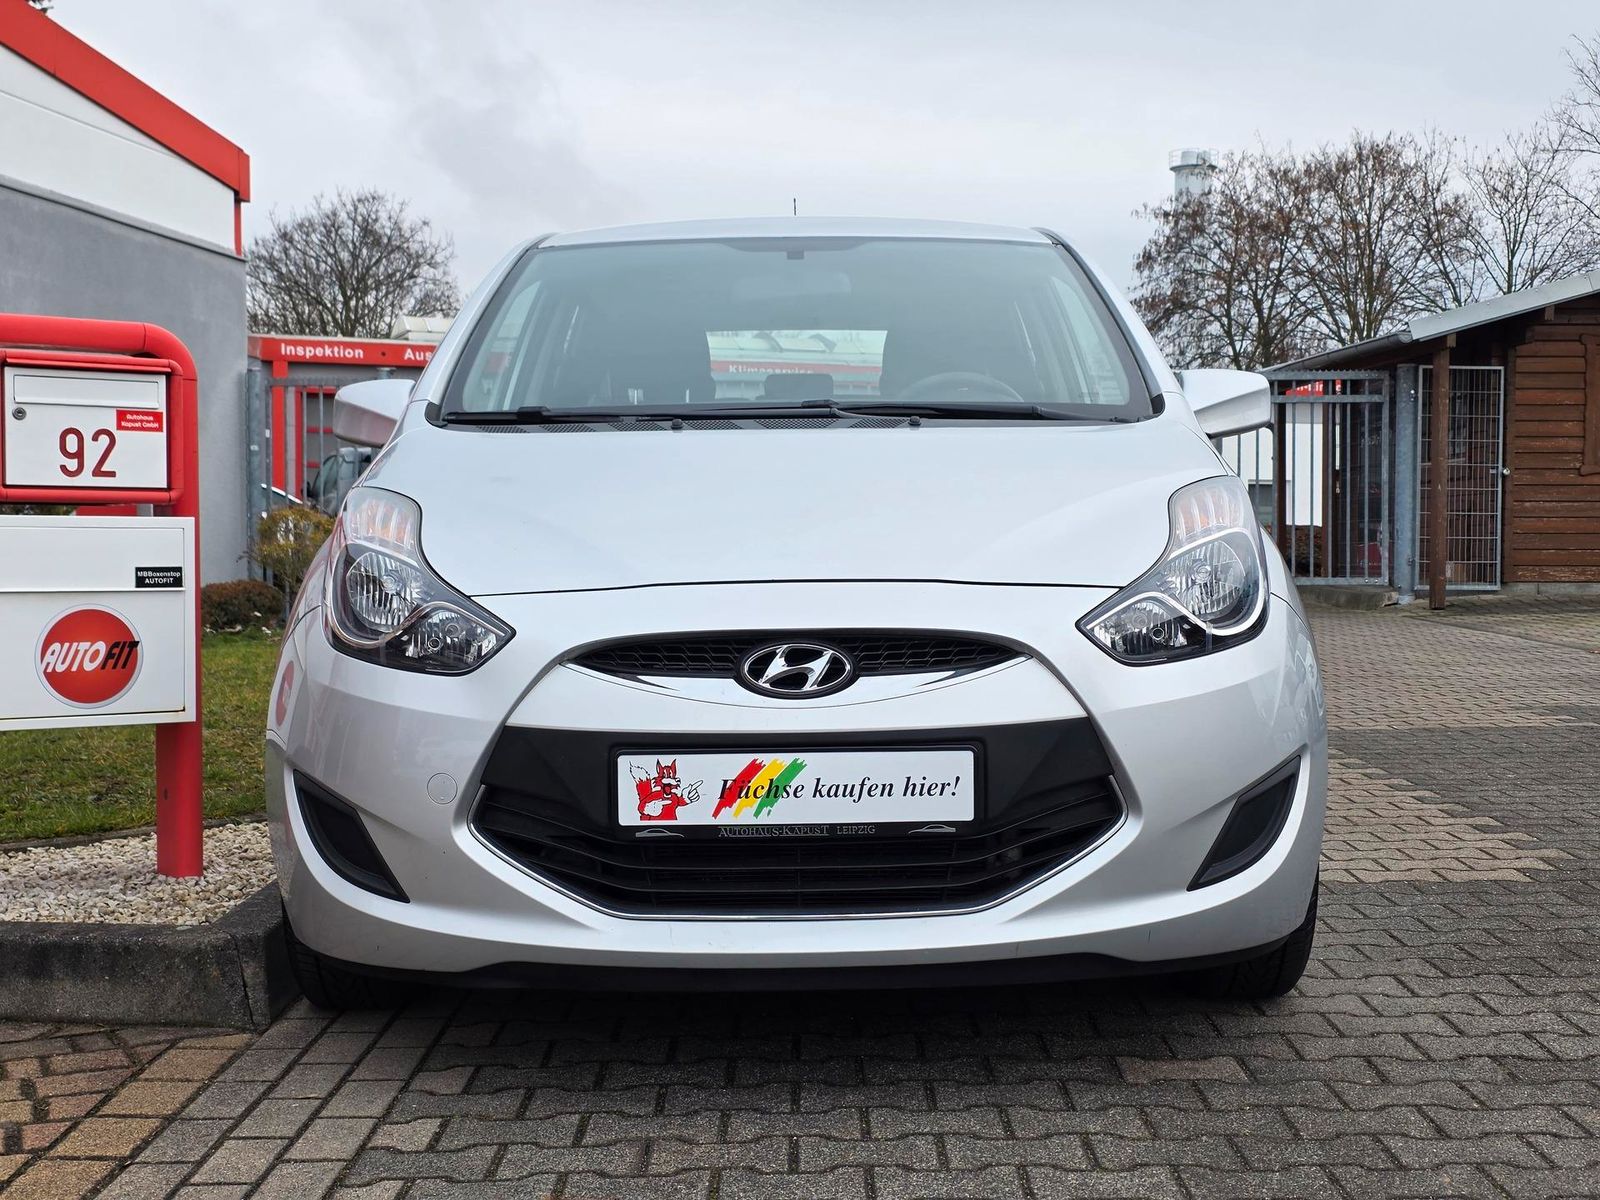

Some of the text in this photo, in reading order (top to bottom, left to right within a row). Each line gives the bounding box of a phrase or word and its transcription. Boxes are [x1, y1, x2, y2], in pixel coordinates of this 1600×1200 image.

[280, 342, 364, 359] Inspektion
[58, 427, 117, 478] 92
[137, 570, 181, 578] MBBoxenstop
[41, 640, 140, 673] AUTOFIT
[717, 775, 961, 803] Füchse kaufen hier!
[836, 825, 876, 835] LEIPZIG
